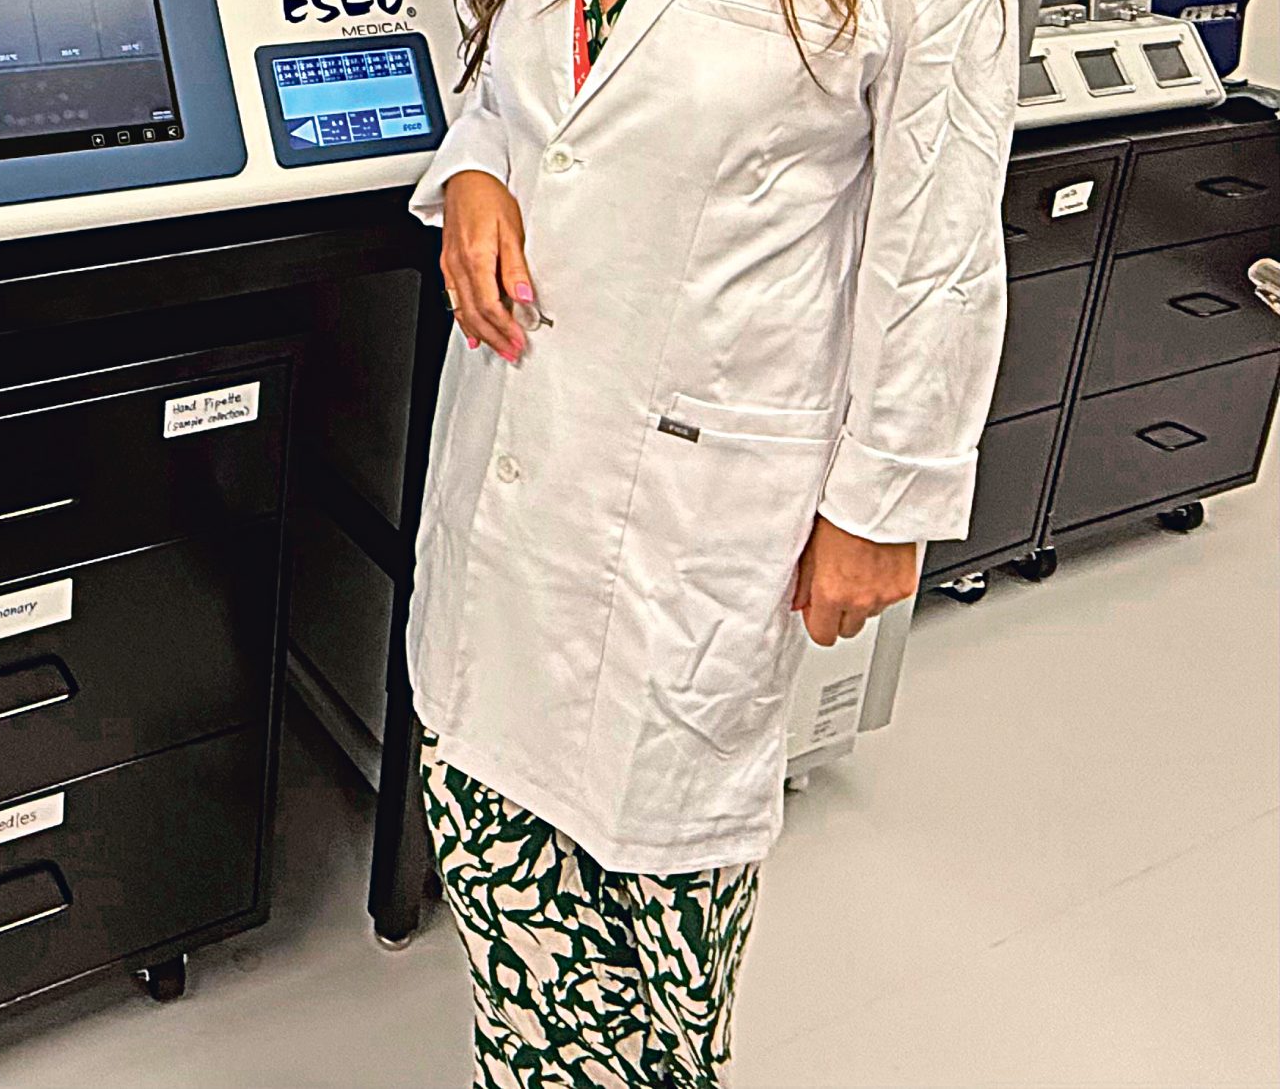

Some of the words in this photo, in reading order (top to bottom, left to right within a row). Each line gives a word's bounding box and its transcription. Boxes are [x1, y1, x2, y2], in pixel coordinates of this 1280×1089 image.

[341, 21, 414, 37] MEDICAL
[173, 400, 197, 414] Hand
[204, 392, 242, 412] Pipette
